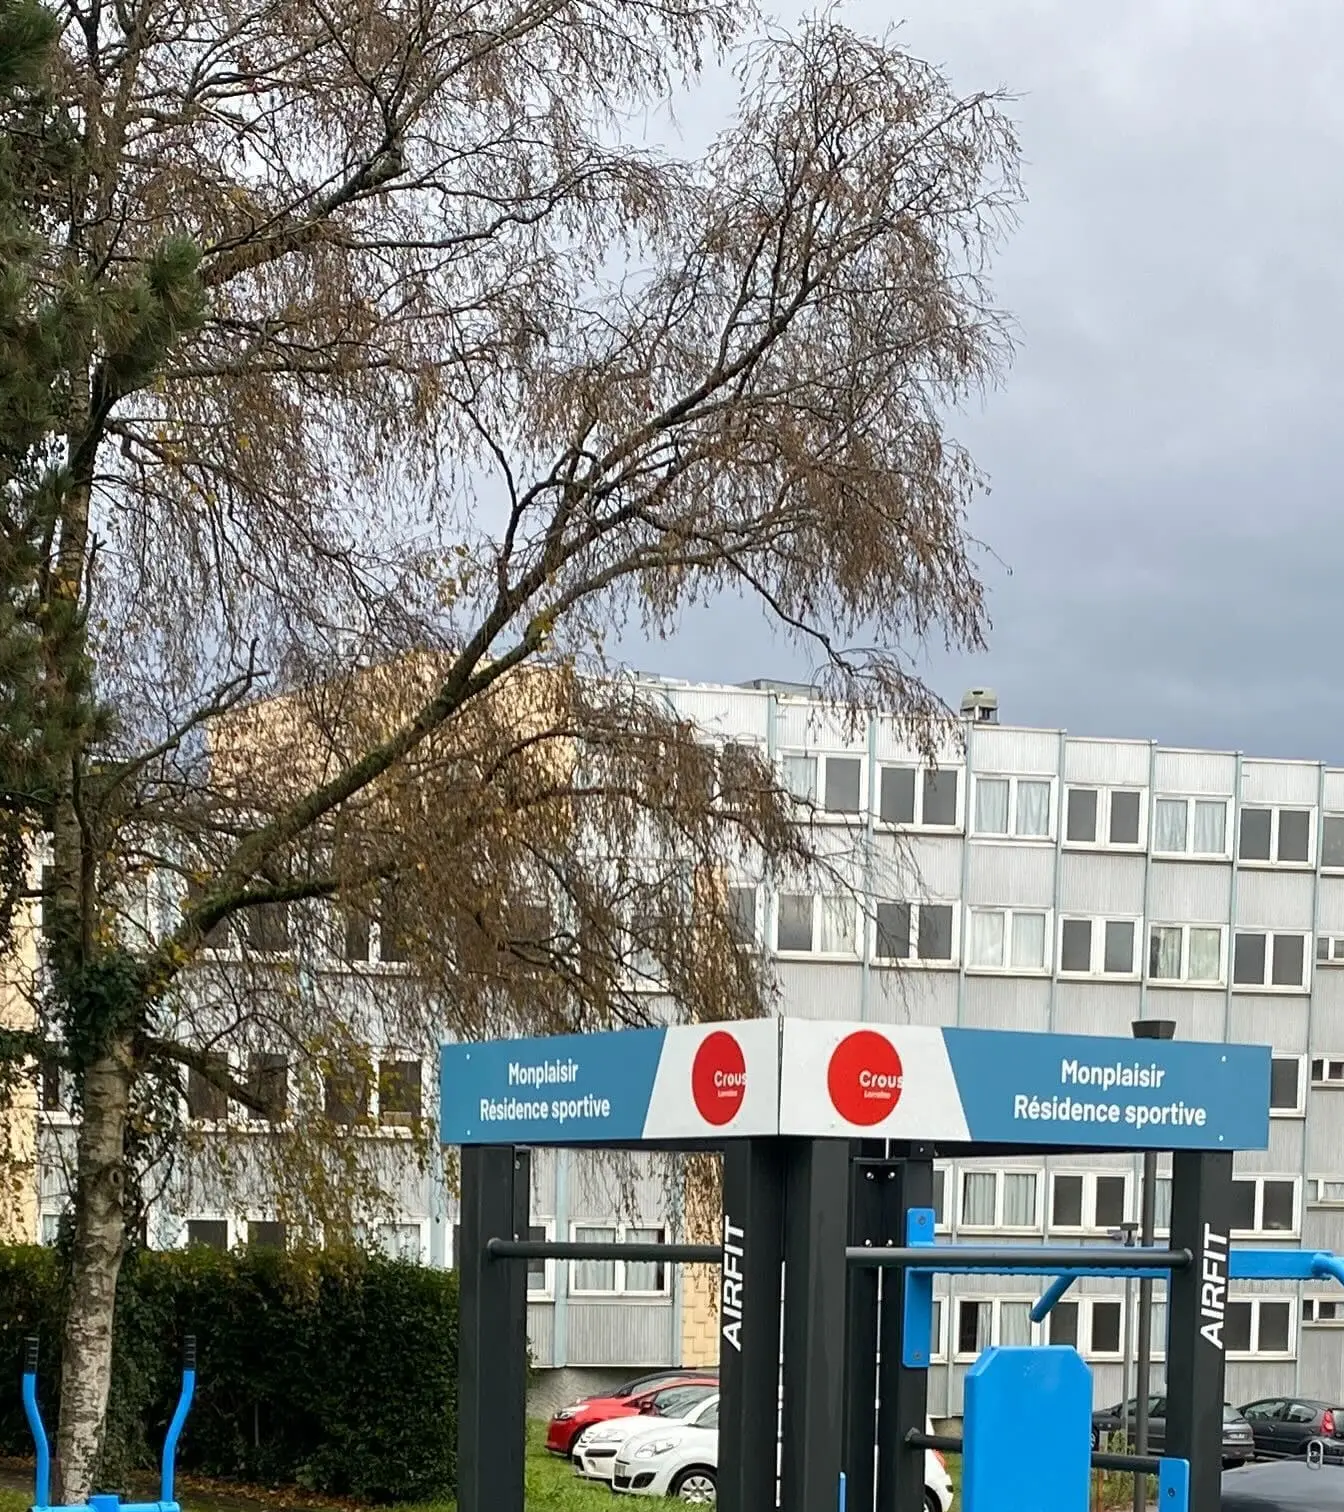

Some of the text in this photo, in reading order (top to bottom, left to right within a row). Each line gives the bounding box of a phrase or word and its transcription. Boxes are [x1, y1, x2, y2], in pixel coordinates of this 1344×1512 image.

[508, 1058, 579, 1089] Monplaisir
[713, 1069, 748, 1088] Crous
[859, 1069, 904, 1089] Crous
[1061, 1058, 1166, 1091] Monplaisir
[480, 1093, 611, 1124] Résidence sportive
[1014, 1094, 1207, 1130] Résidence sportive
[722, 1214, 745, 1352] AIRFIT
[1200, 1222, 1228, 1350] AIRFIT
